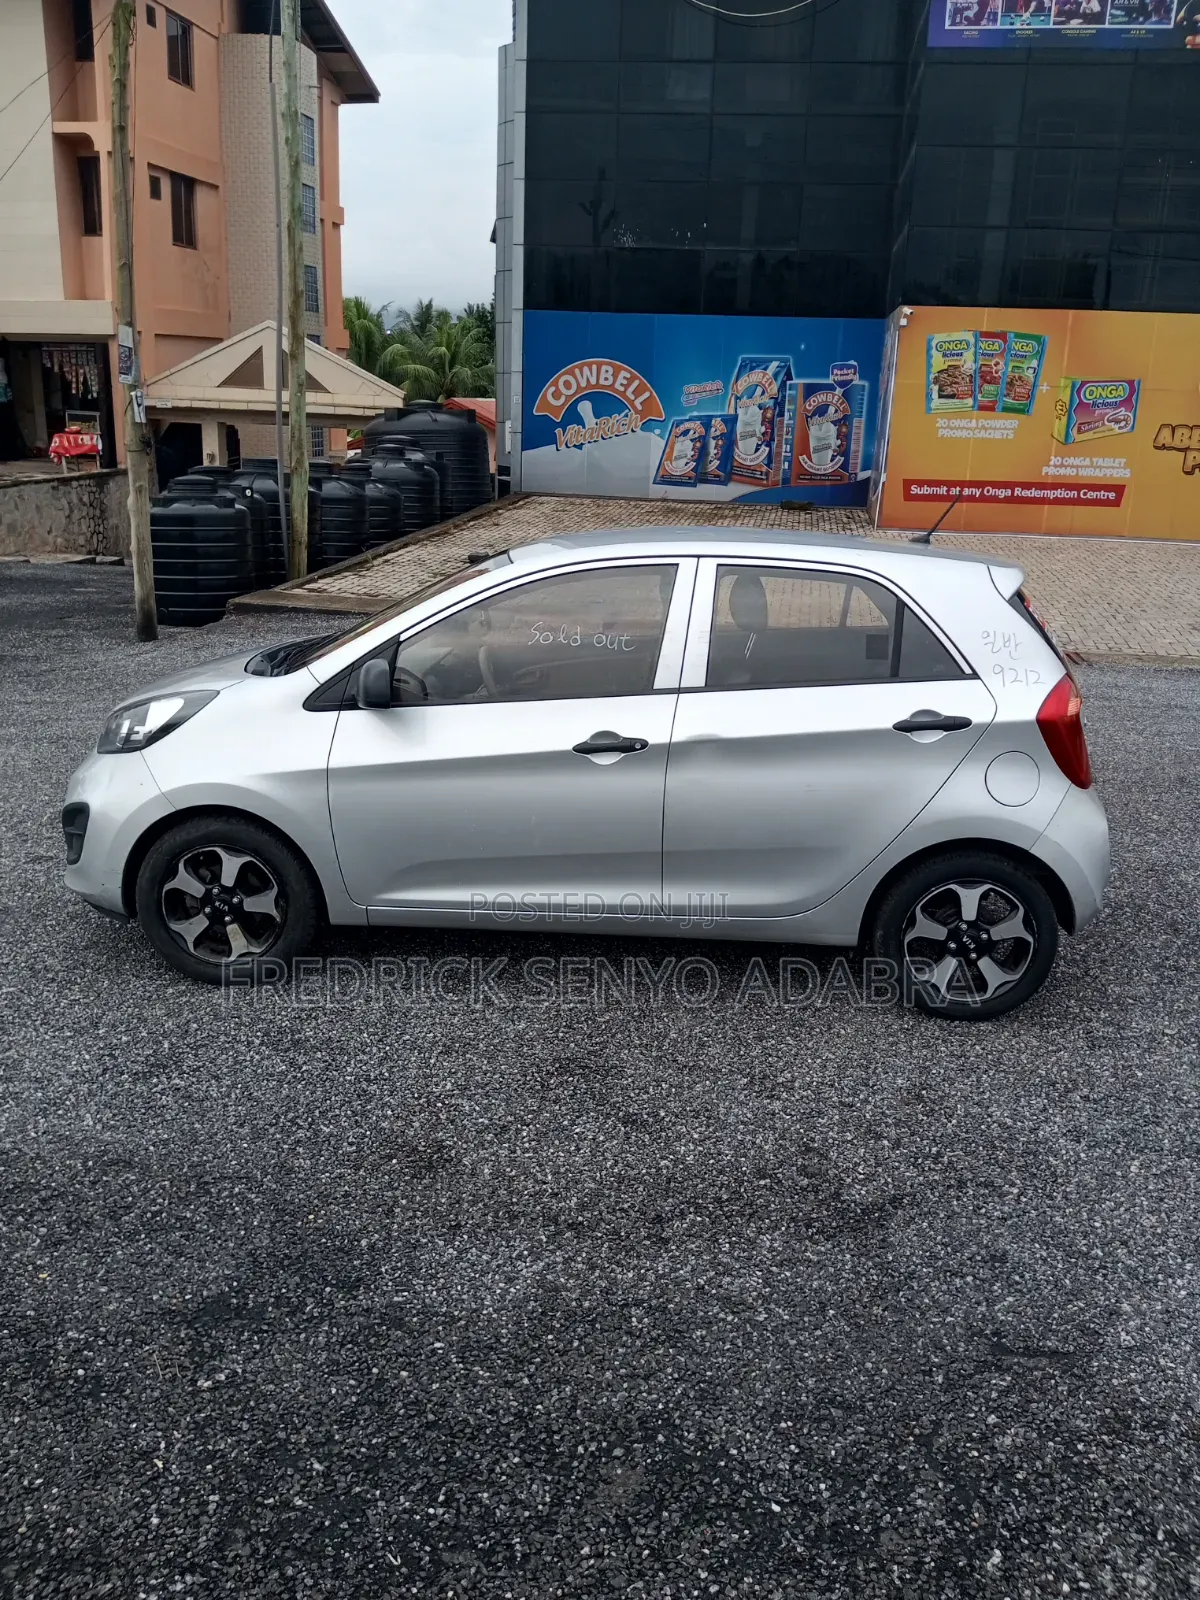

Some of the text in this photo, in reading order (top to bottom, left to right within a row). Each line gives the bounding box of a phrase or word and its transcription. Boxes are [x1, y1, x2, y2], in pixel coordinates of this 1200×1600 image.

[936, 341, 968, 352] ONGA
[979, 341, 1000, 351] NGA
[1011, 341, 1034, 353] NGA
[942, 351, 963, 359] licious
[546, 364, 650, 411] COWBELL
[737, 372, 776, 393] COWBELL
[1086, 385, 1125, 400] ONGA
[805, 393, 847, 411] COWBELL
[1090, 400, 1119, 409] licious
[676, 421, 702, 435] COWBELL
[936, 418, 1019, 429] 20 ONGA POWDER
[1080, 420, 1104, 432] Shrimp
[555, 410, 641, 450] VitaRich
[938, 429, 1015, 439] PROMO SACHETS
[1049, 456, 1126, 467] 20 ONGA TABLET
[1042, 467, 1131, 478] PROMO WRAPPERS
[910, 485, 1116, 500] Submit at any Onga Redemption Centre
[528, 621, 636, 651] Sold out
[993, 663, 1047, 688] 9212
